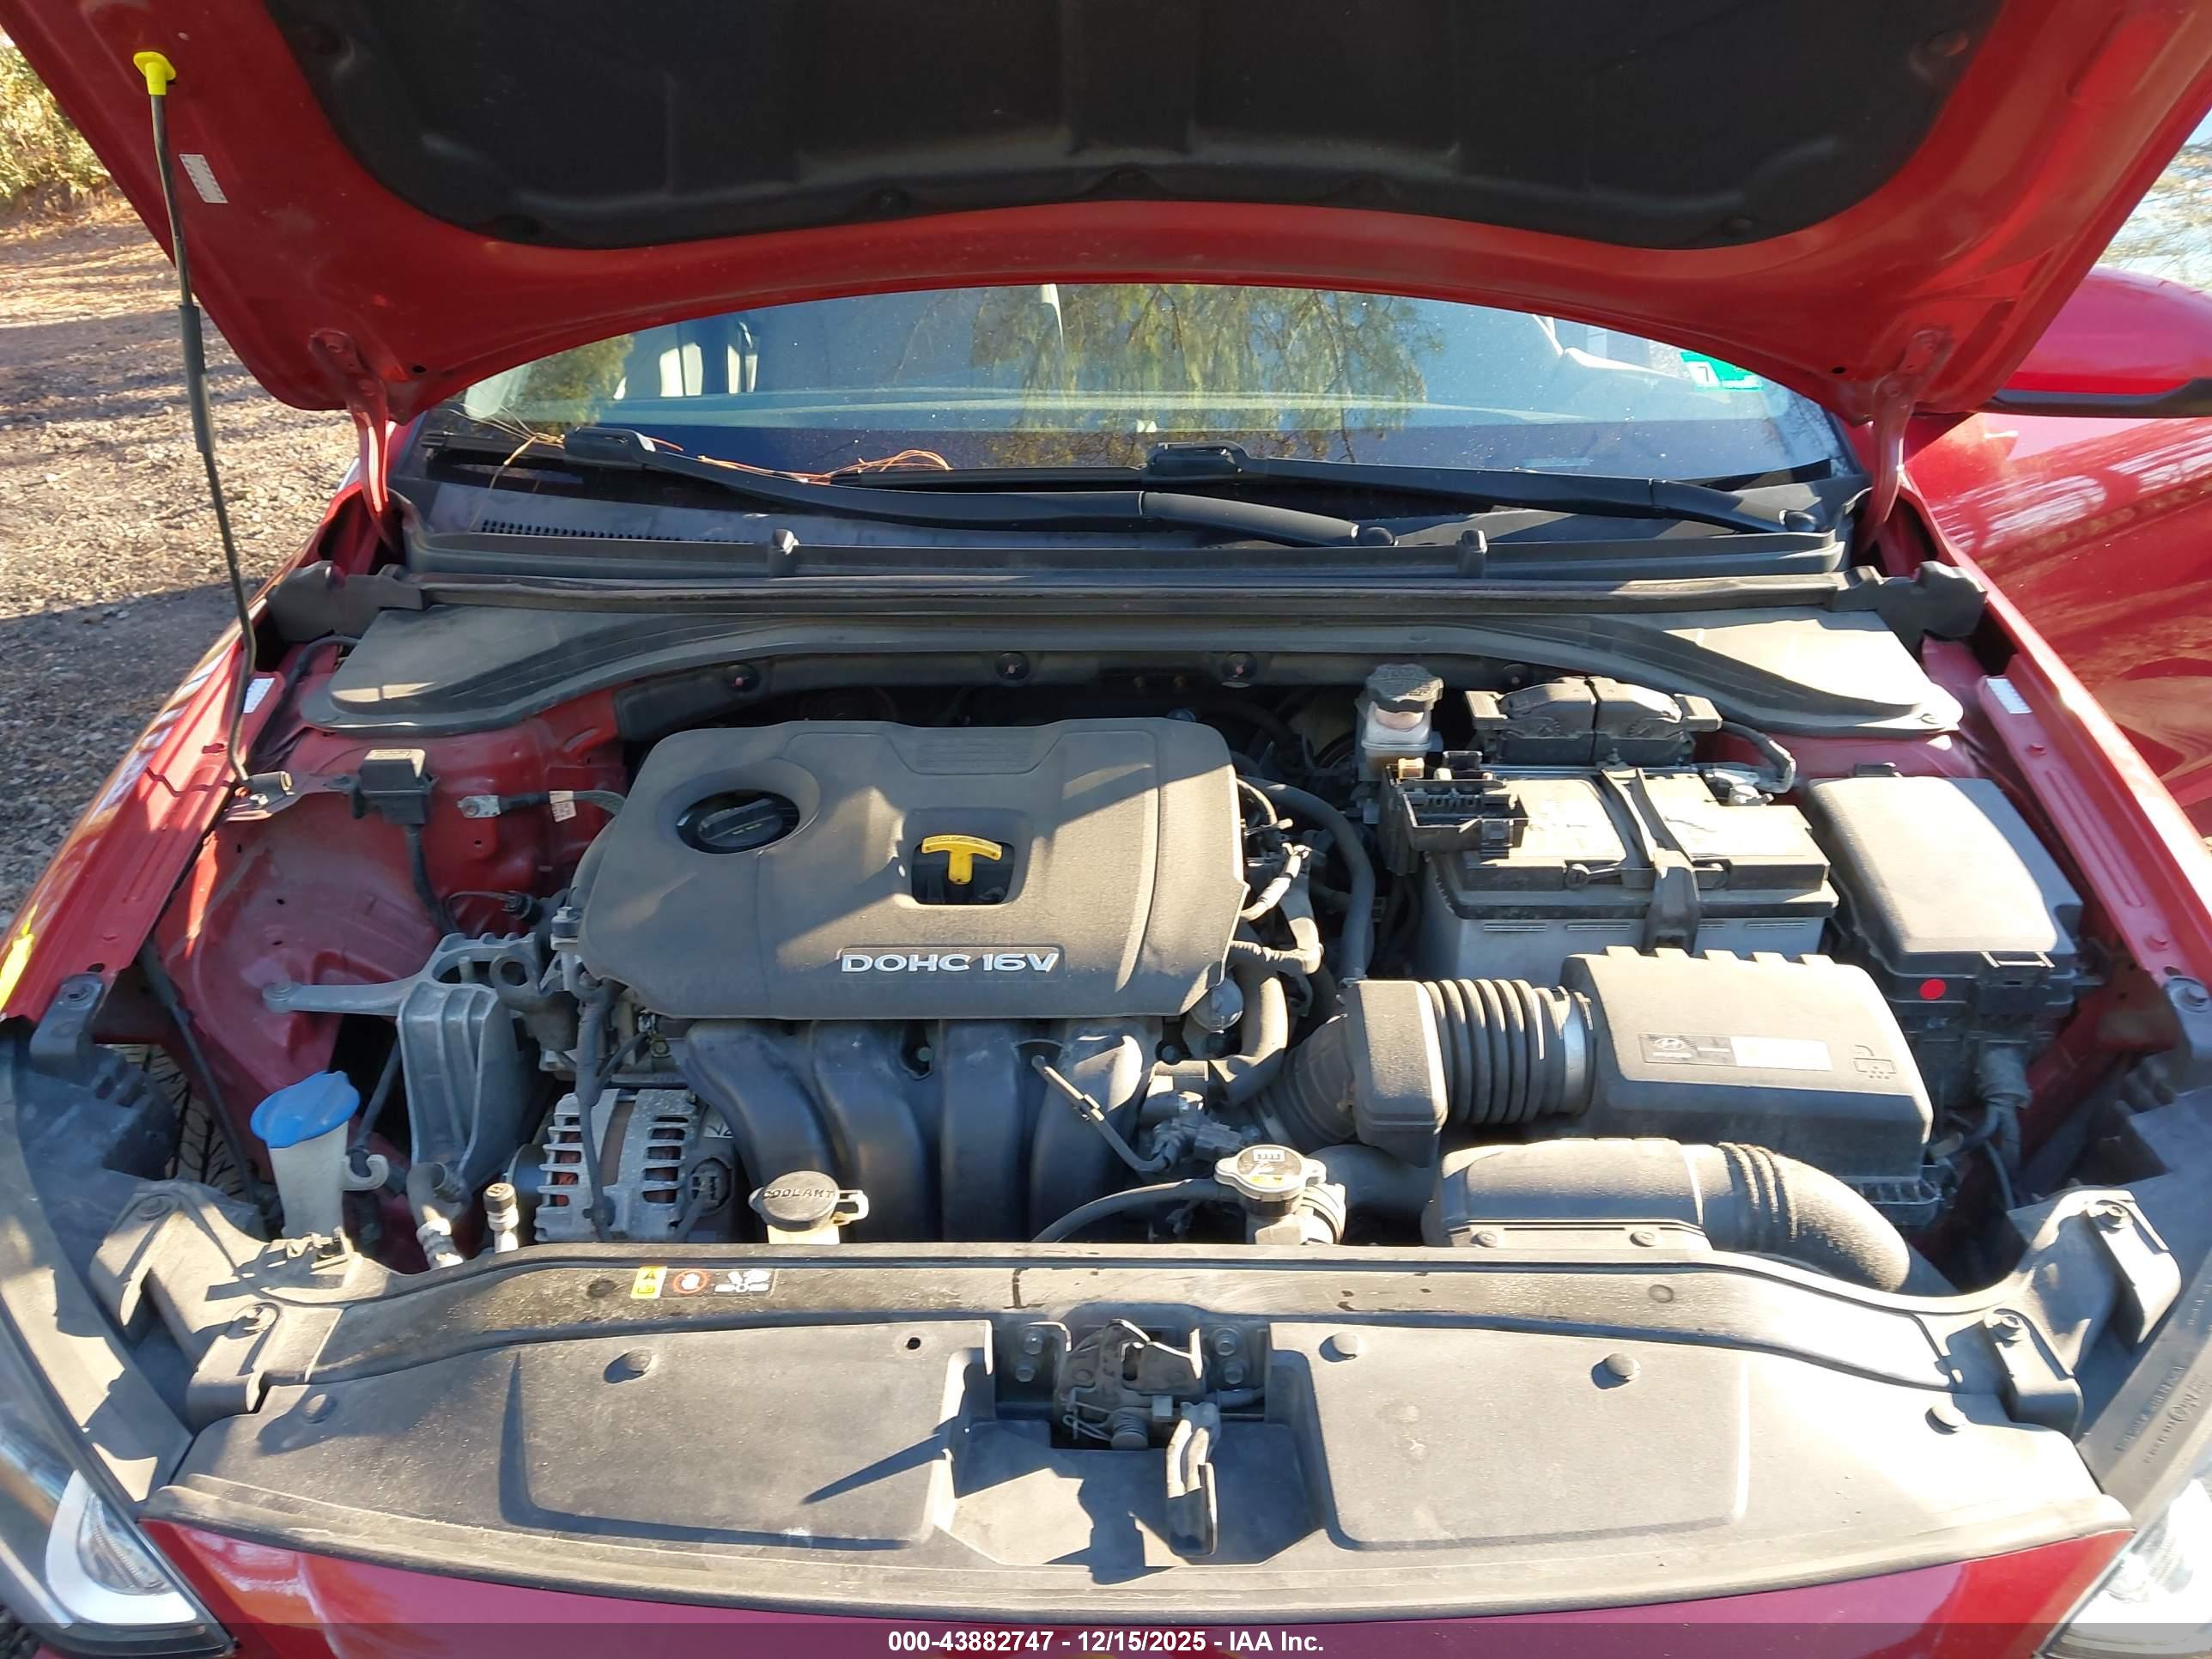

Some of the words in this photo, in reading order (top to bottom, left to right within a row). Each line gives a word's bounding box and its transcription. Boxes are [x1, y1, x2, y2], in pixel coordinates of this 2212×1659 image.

[841, 953, 972, 972] DOHC
[981, 953, 1060, 973] 16V
[763, 1188, 836, 1199] COOLANT
